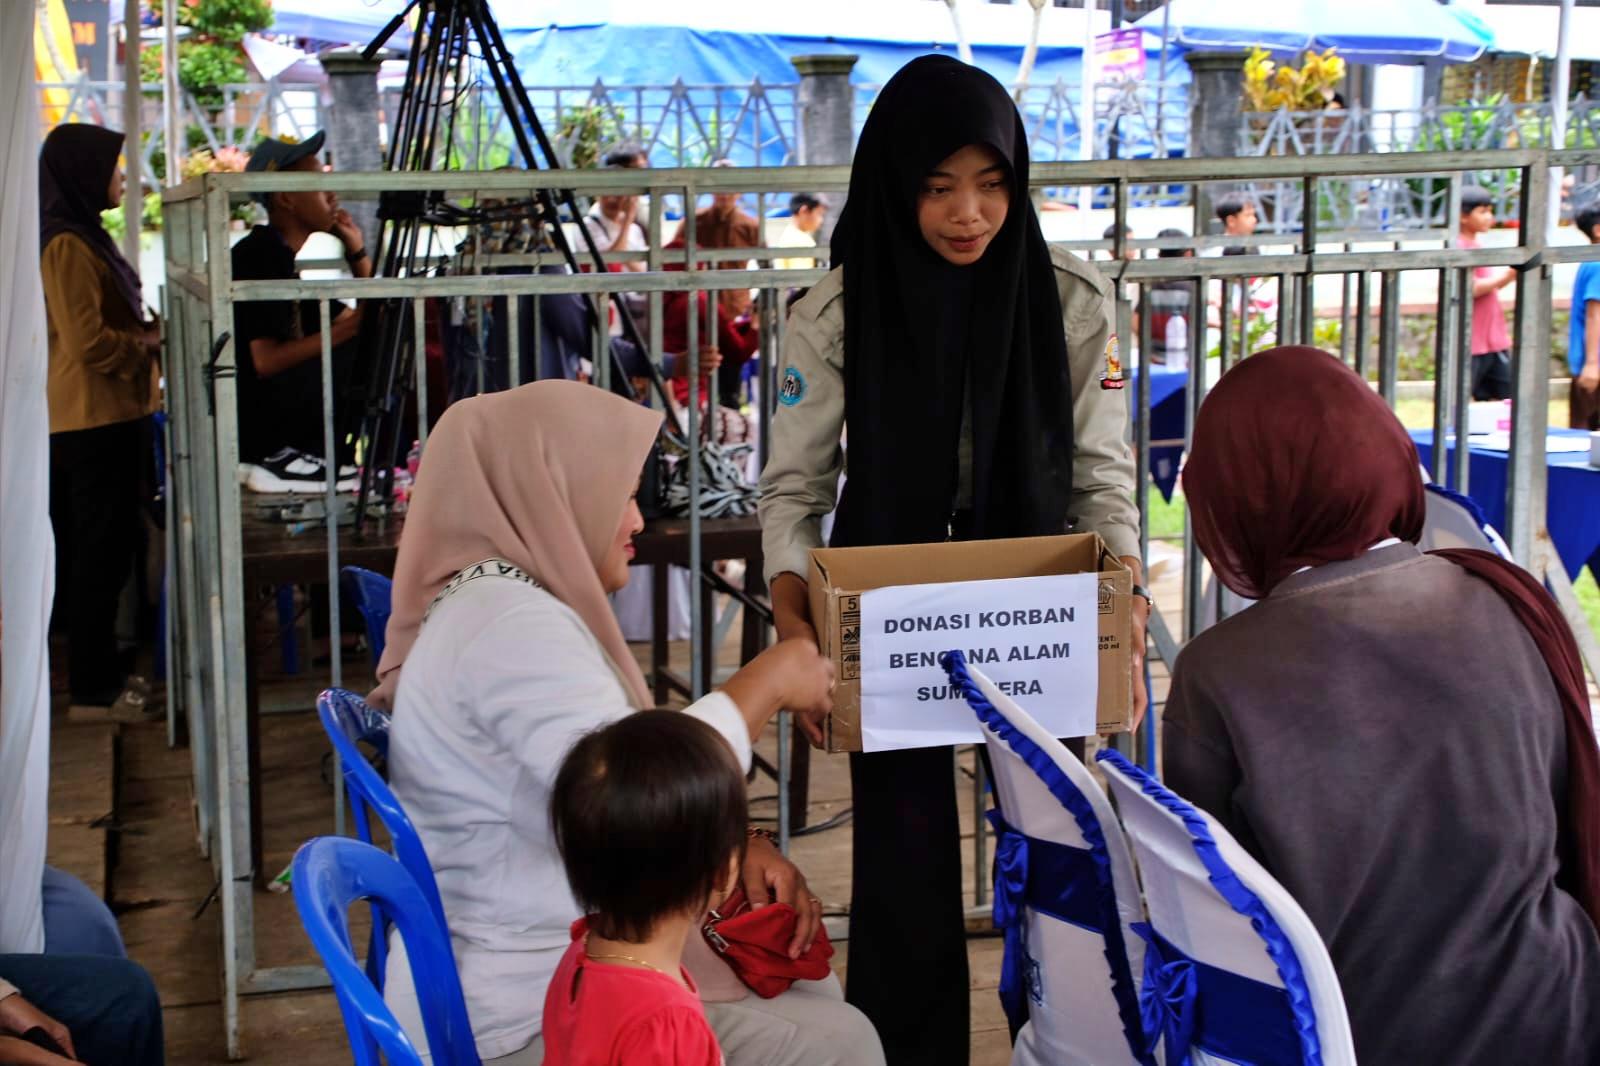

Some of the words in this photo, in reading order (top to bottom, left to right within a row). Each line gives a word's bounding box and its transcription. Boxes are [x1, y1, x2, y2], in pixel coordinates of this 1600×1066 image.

[848, 598, 857, 610] 5
[884, 613, 970, 634] DONASI
[979, 607, 1075, 628] KORBAN
[890, 648, 1000, 668] BENNA
[1007, 643, 1070, 662] ALAM
[917, 679, 1043, 701] SUMERA
